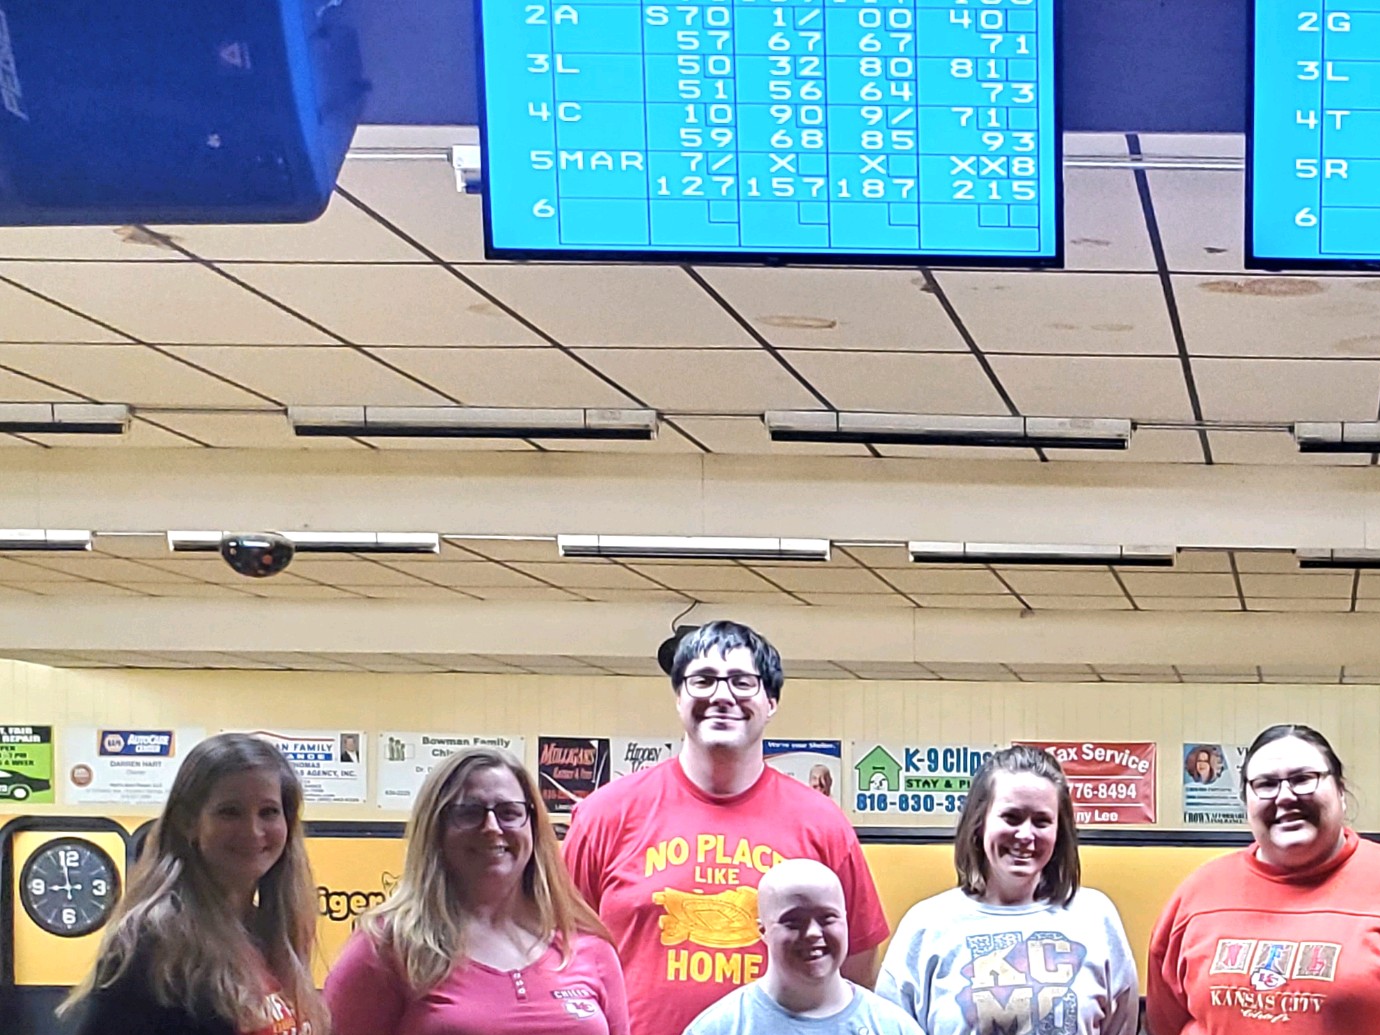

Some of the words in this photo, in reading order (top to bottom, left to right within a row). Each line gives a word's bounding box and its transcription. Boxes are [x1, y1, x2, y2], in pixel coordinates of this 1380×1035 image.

[525, 6, 547, 24] 2
[554, 5, 579, 24] A
[645, 6, 730, 26] S70
[773, 7, 821, 26] 1/
[858, 8, 912, 28] 00
[949, 10, 1003, 29] 40
[1297, 12, 1320, 31] 2
[1327, 12, 1351, 31] G
[676, 31, 730, 49] 57
[768, 32, 822, 51] 67
[858, 33, 913, 52] 67
[980, 34, 1030, 54] 71
[527, 54, 550, 72] 3
[555, 54, 580, 73] L
[677, 55, 731, 74] 50
[768, 56, 822, 76] 32
[859, 57, 913, 77] 80
[950, 58, 1000, 78] 81
[1297, 61, 1320, 80] 3
[1326, 62, 1349, 80] L
[678, 80, 728, 98] 51
[769, 81, 823, 100] 56
[859, 82, 913, 101] 64
[981, 83, 1035, 103] 73
[528, 103, 551, 121] 4
[557, 102, 582, 121] C
[685, 104, 733, 123] 10
[769, 105, 823, 124] 90
[860, 106, 914, 125] 9/
[951, 107, 1001, 127] 71
[1296, 111, 1318, 129] 4
[1326, 111, 1351, 129] T
[679, 128, 733, 147] 59
[770, 129, 824, 148] 68
[861, 130, 915, 149] 85
[981, 132, 1035, 151] 93
[530, 151, 554, 169] 5
[559, 151, 644, 170] MAR
[680, 152, 734, 171] 7/
[768, 154, 796, 172] X
[859, 155, 887, 173] X
[949, 156, 1036, 176] XX8
[1295, 159, 1318, 178] 5
[1324, 159, 1348, 178] R
[657, 176, 735, 195] 127
[747, 178, 825, 197] 157
[837, 179, 915, 198] 187
[952, 180, 1036, 200] 215
[532, 199, 555, 217] 6
[1294, 208, 1318, 226] 6
[294, 743, 333, 751] FAMILY
[422, 736, 470, 745] Bowman
[473, 737, 511, 748] Family
[904, 747, 939, 773] K-9
[1081, 743, 1150, 773] Service
[906, 778, 939, 789] STAY
[944, 779, 952, 788] &
[1094, 809, 1119, 822] Lee
[58, 850, 80, 867] 12
[644, 837, 690, 878] NO
[694, 865, 740, 885] LIKE
[31, 879, 46, 895] 9
[91, 879, 107, 896] 3
[61, 908, 76, 924] 6
[666, 948, 764, 984] HOME
[1210, 989, 1276, 1012] KANSAS
[1280, 994, 1323, 1013] CITY
